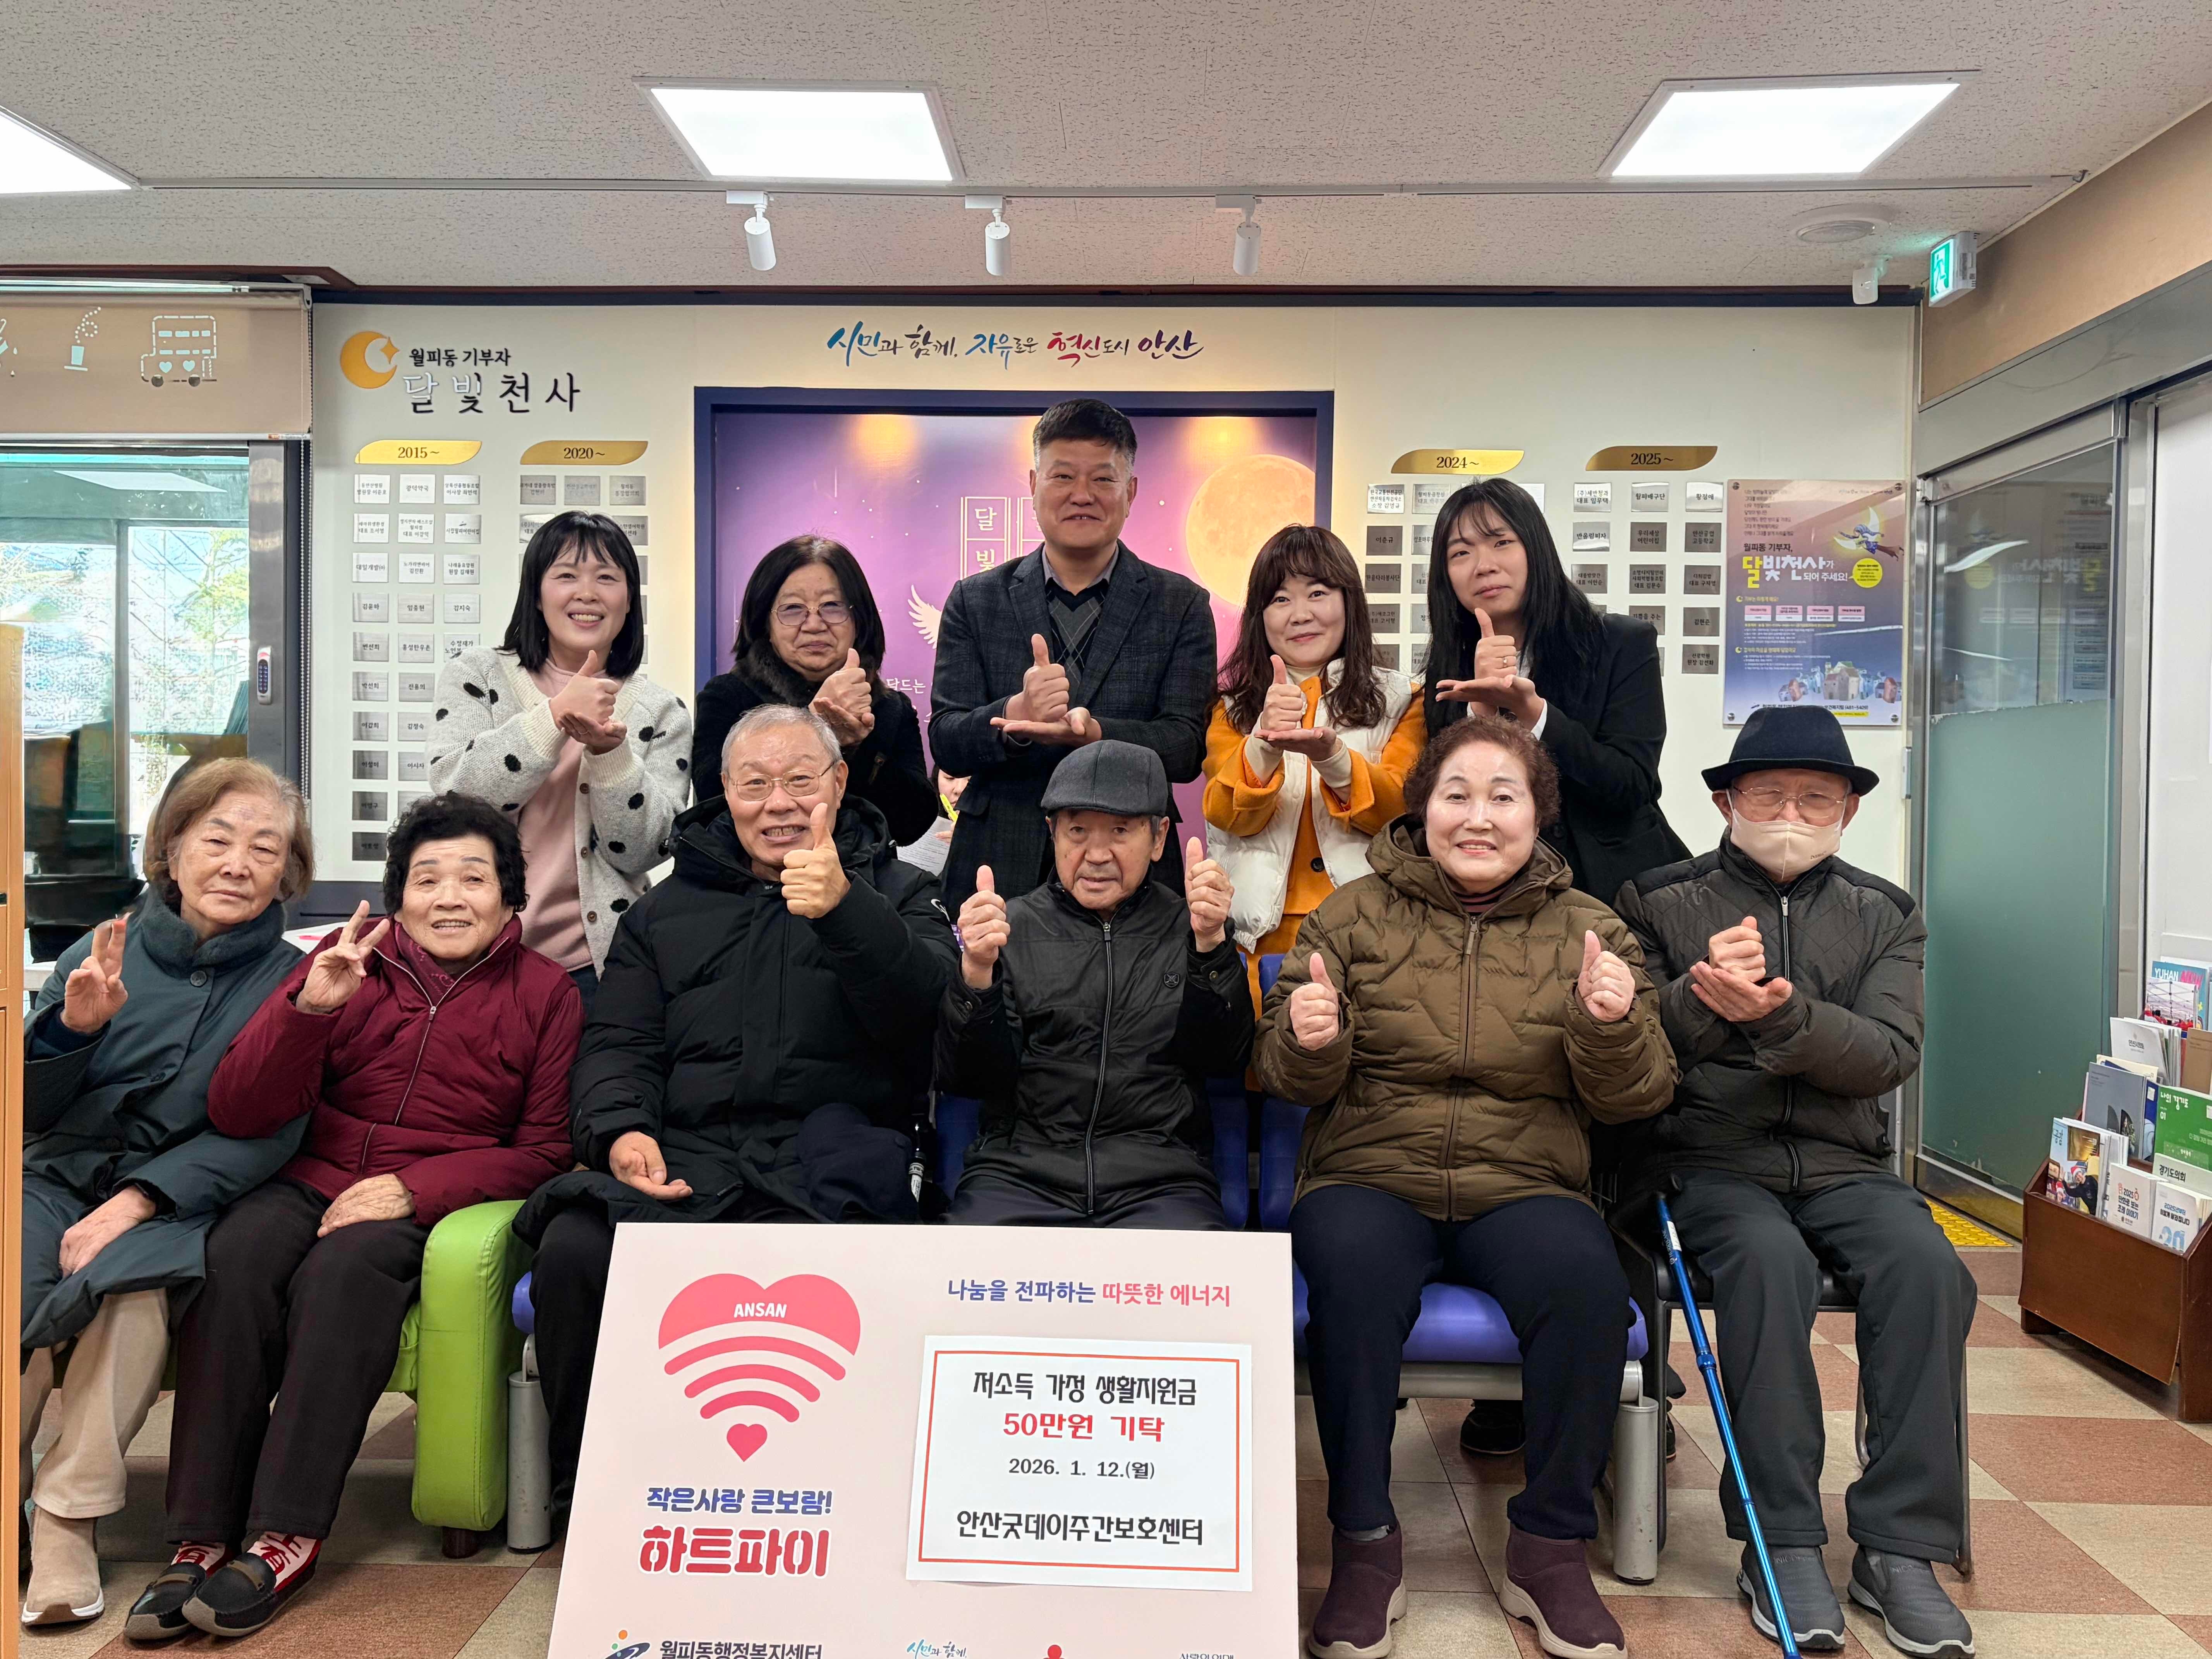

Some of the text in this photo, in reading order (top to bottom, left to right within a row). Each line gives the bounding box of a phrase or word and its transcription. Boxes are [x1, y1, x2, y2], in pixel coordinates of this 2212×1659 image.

[827, 321, 1204, 370] 시민과 함께, 자유로운 혁신도시 안산
[409, 348, 511, 367] 월피동 기부자
[1769, 544, 1793, 552] 기부자,
[1803, 572, 1819, 581] 되어
[1821, 572, 1848, 581] 주세요!
[2155, 968, 2179, 981] YUHAN
[2160, 1091, 2189, 1111] 나의 경기도
[2160, 1111, 2166, 1120] 01
[2159, 1164, 2186, 1182] 경기도의회
[948, 1279, 1231, 1307] 나눔을 전파하는 따뜻한 에너지
[734, 1302, 787, 1318] ANSAN
[973, 1372, 1197, 1406] 저소득 가정 생활지원금
[1003, 1413, 1165, 1442] 50만원 기탁
[1009, 1458, 1155, 1480] 2026. 1. 12.(월)
[647, 1487, 832, 1515] 작은사랑 큰보람!
[957, 1510, 1203, 1546] 안산굿데이주간보호센터
[640, 1525, 829, 1577] 하트파이
